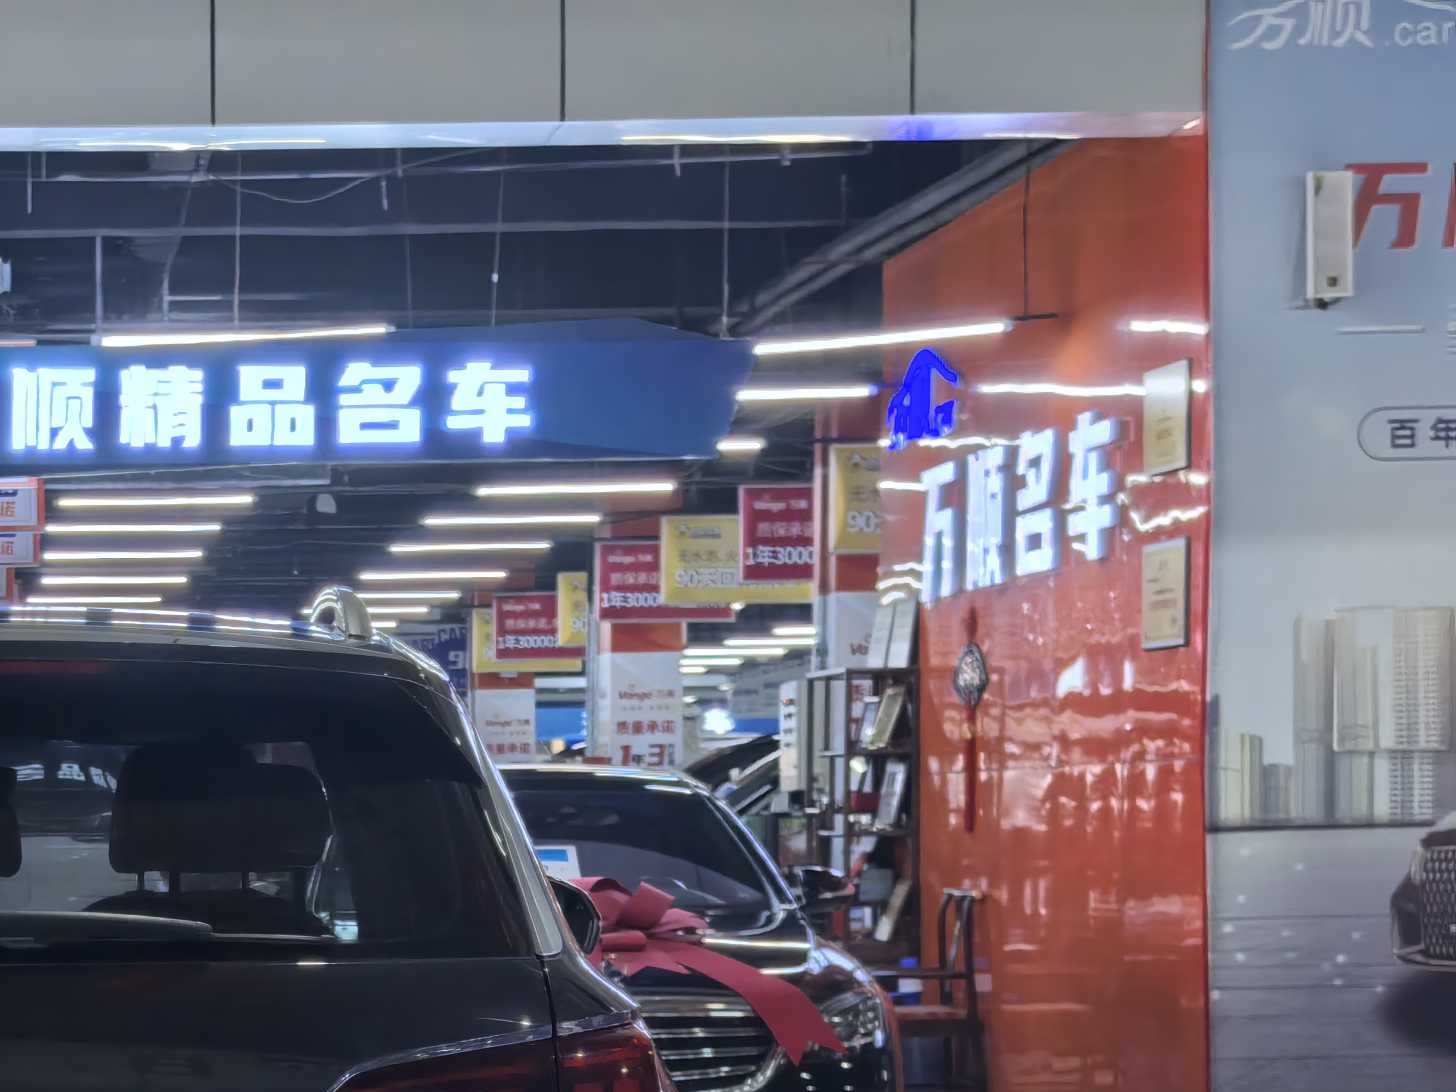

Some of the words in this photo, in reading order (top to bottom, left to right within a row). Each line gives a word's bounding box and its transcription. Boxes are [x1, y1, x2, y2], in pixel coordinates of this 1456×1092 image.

[1227, 0, 1375, 51] 万顺
[1344, 162, 1456, 250] 万
[920, 410, 1121, 609] 万顺名车
